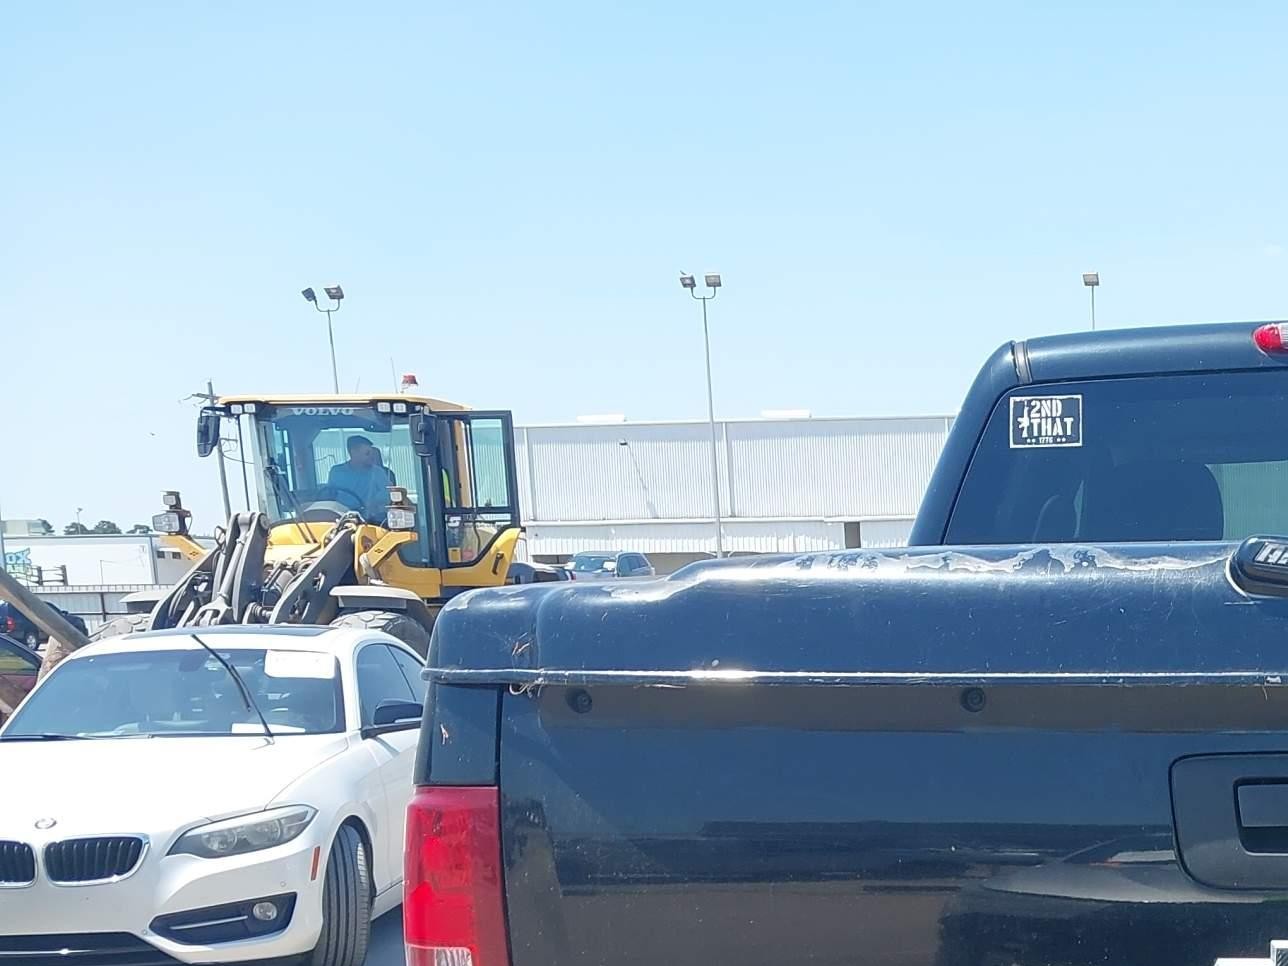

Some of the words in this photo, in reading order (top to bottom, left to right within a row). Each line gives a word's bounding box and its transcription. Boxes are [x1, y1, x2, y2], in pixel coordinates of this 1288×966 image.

[292, 407, 354, 416] VOLVO
[1030, 399, 1063, 418] 2ND
[1030, 417, 1074, 437] THAT
